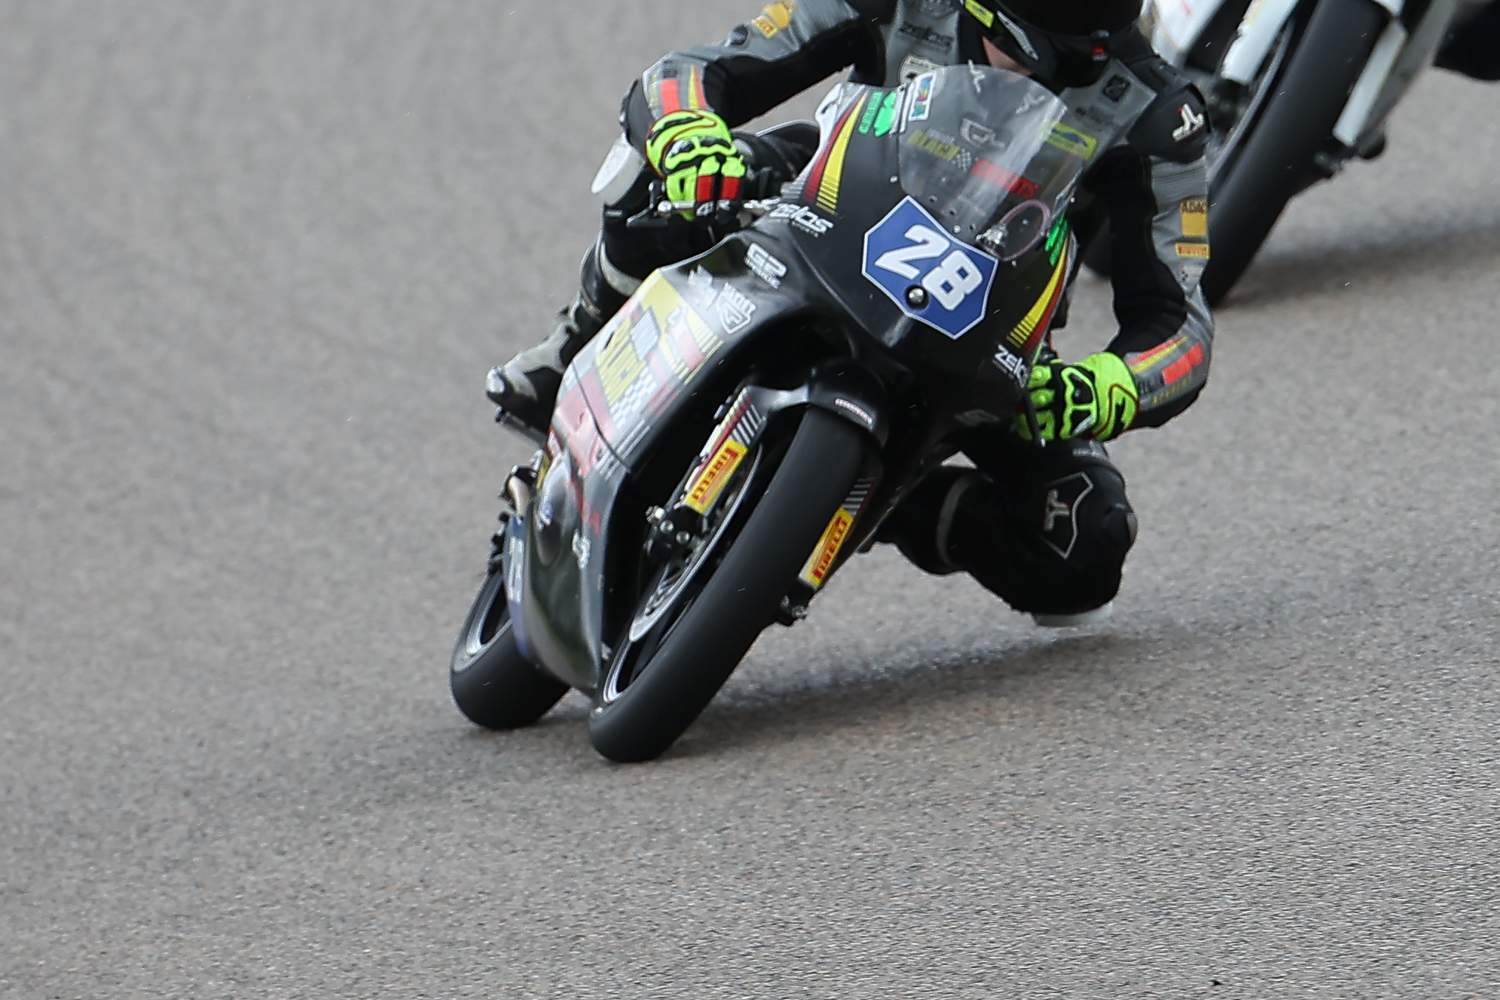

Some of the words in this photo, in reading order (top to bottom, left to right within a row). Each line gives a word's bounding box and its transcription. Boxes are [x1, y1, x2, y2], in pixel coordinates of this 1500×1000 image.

[747, 243, 787, 277] GP
[874, 224, 983, 311] 28
[692, 447, 740, 504] PIRELLI
[812, 515, 848, 578] PIRELLI
